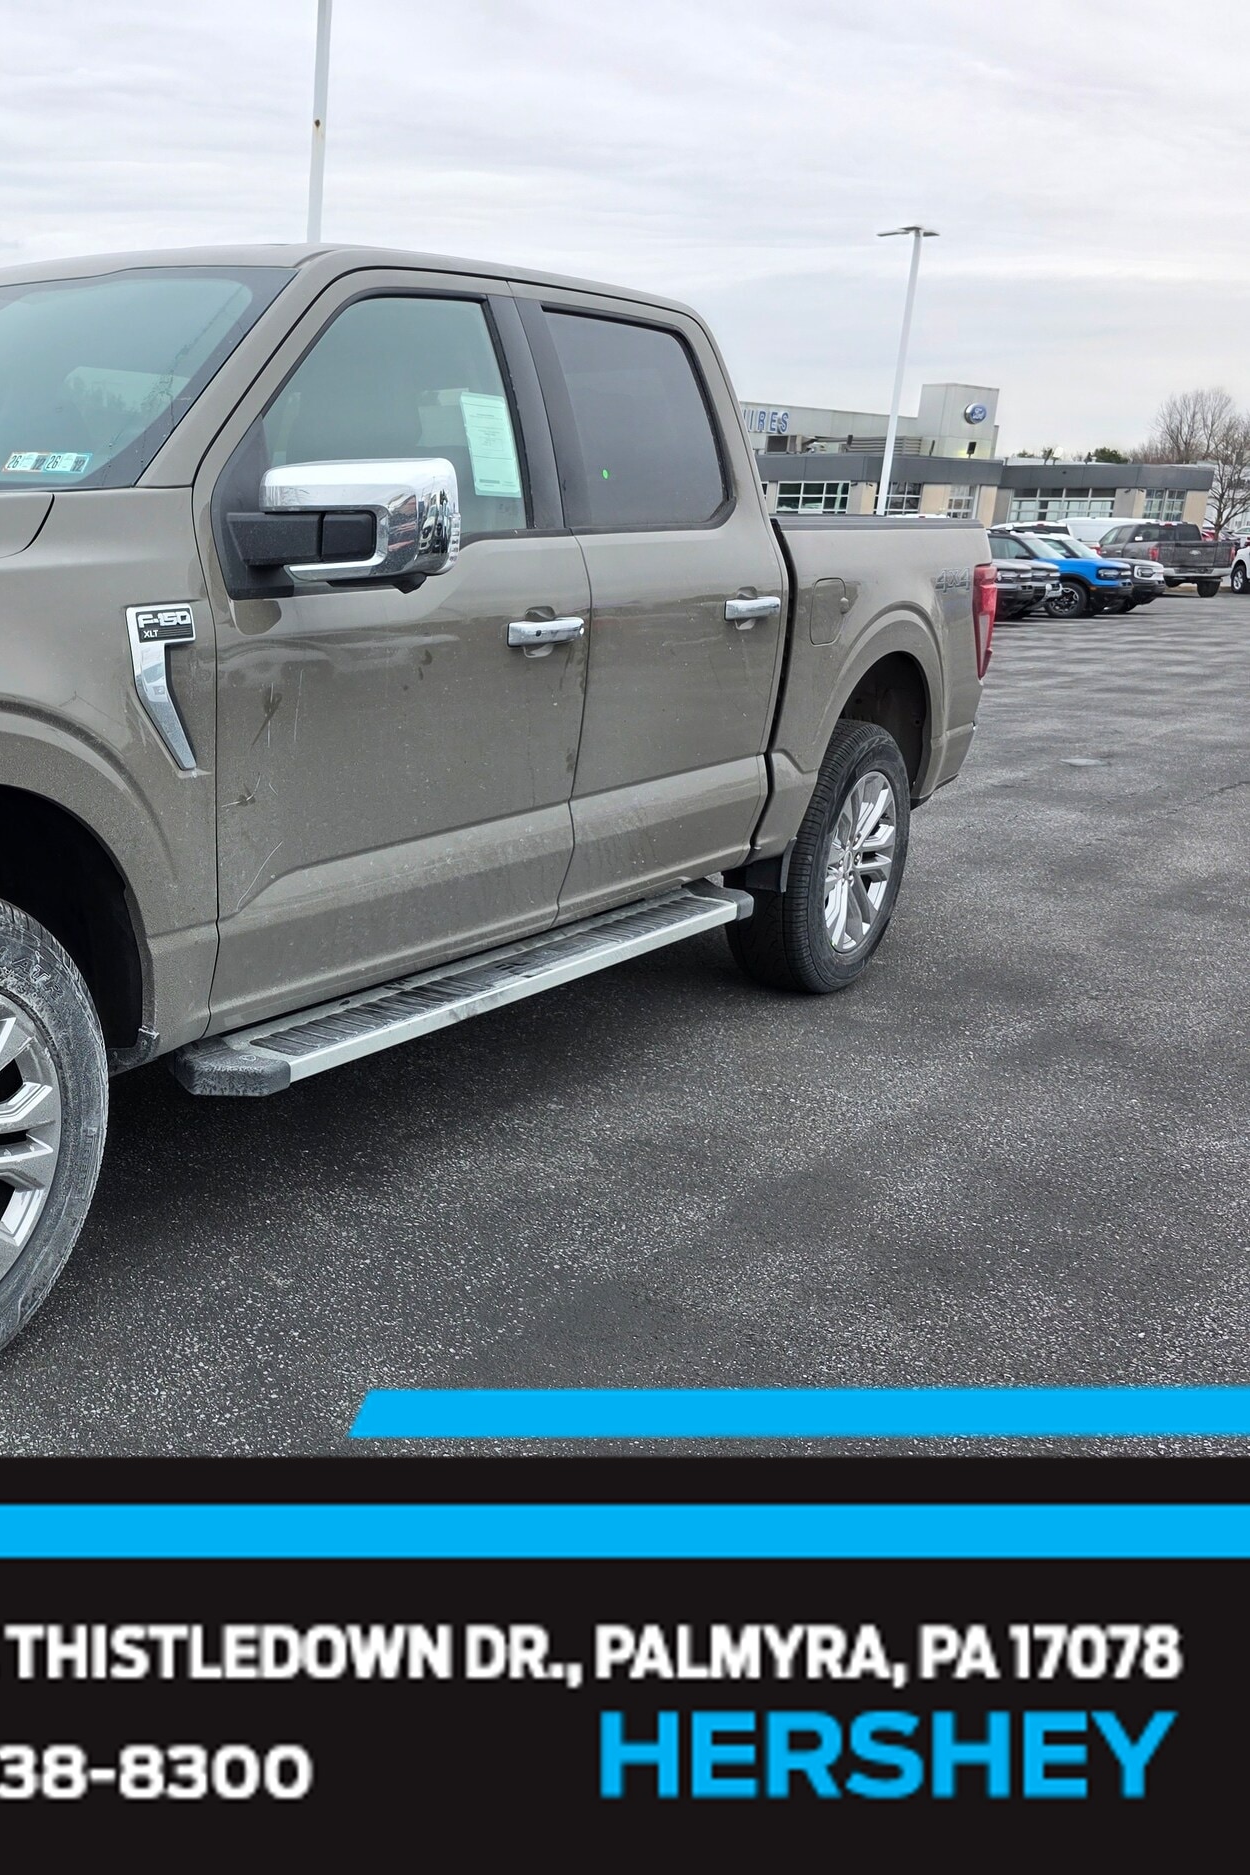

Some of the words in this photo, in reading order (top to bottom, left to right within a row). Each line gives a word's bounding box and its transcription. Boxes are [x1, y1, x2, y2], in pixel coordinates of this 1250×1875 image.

[7, 455, 22, 469] 26
[31, 458, 47, 471] 12
[46, 455, 61, 469] 26
[137, 610, 191, 628] F-150
[143, 629, 159, 639] XLT
